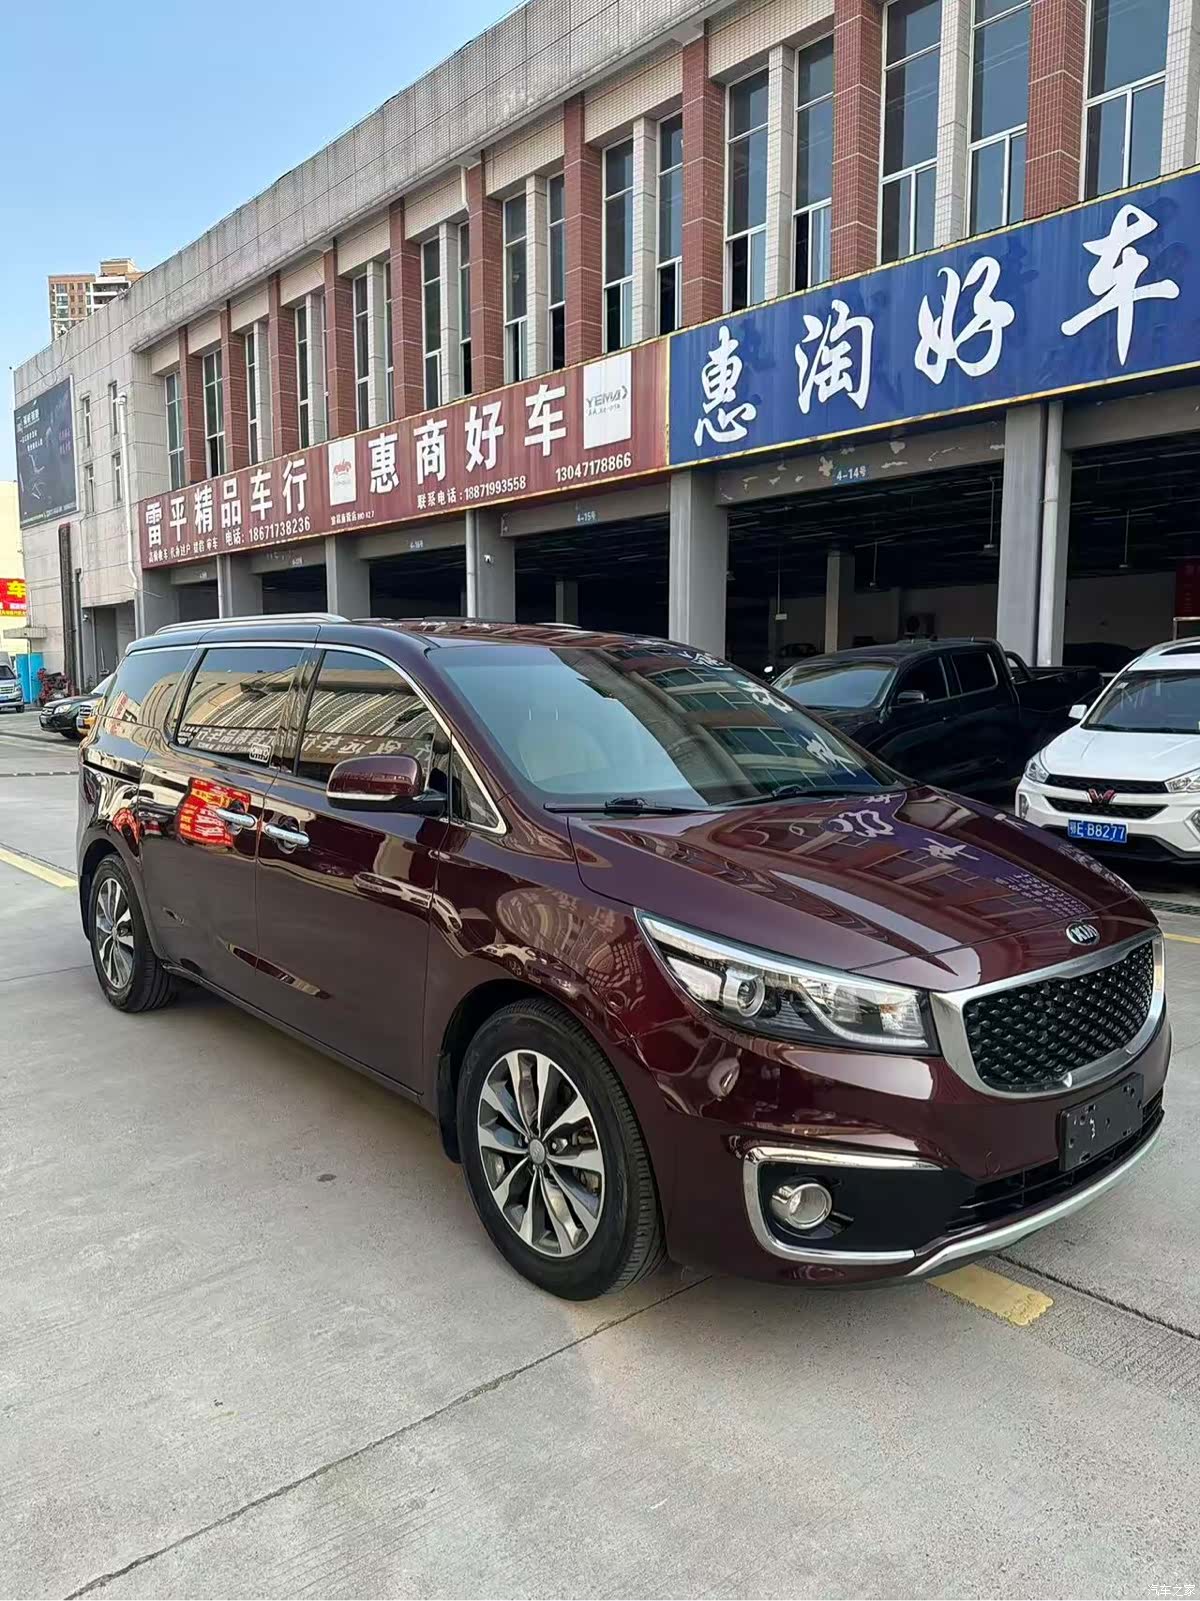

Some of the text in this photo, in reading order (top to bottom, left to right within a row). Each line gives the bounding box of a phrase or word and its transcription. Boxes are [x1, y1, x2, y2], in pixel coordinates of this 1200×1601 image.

[693, 203, 1180, 447] 惠淘好车
[368, 384, 569, 494] 惠商好车
[555, 452, 632, 483] 13047178866
[145, 458, 308, 547] 雷平精品车行
[1070, 924, 1097, 942] KIA
